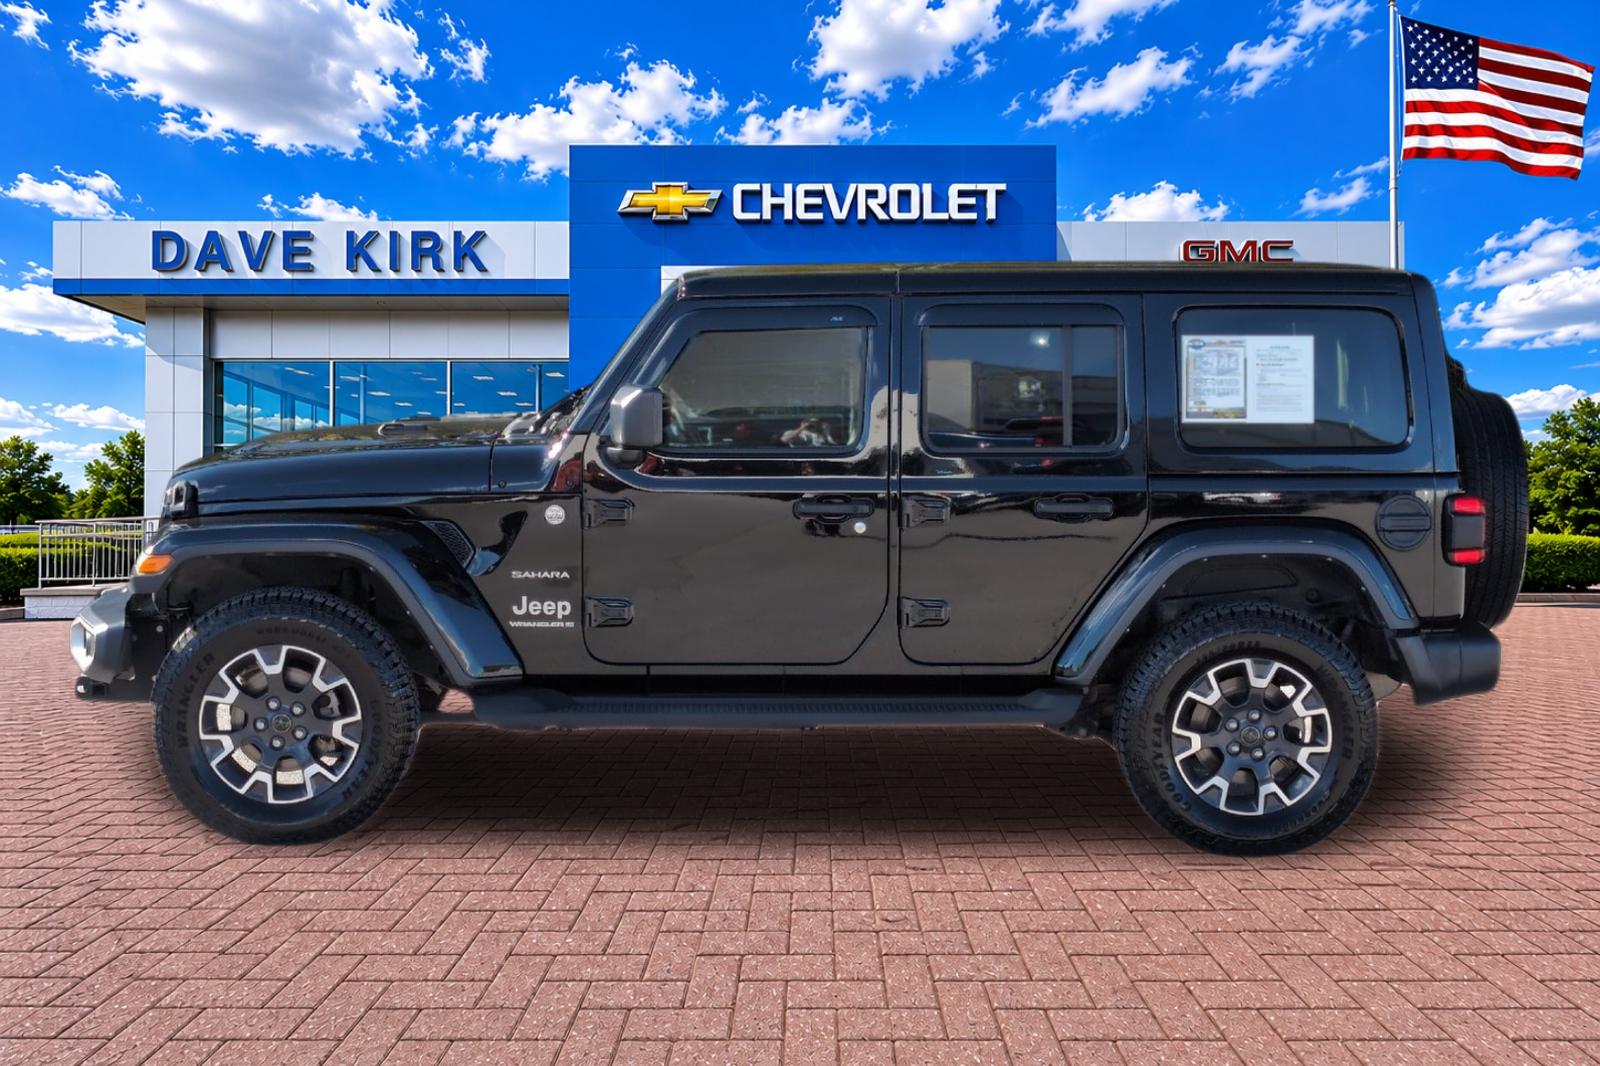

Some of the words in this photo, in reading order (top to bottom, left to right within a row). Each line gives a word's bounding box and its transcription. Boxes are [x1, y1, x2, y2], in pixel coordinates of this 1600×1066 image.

[732, 183, 1007, 222] CHEVROLET
[152, 230, 314, 272] DAVE
[346, 230, 488, 272] KIRK
[1182, 239, 1294, 262] GMC
[511, 571, 570, 579] SAHARA
[512, 596, 572, 619] Jeep
[176, 653, 216, 750] WRANGLER
[1150, 711, 1193, 814] GOODYEAR
